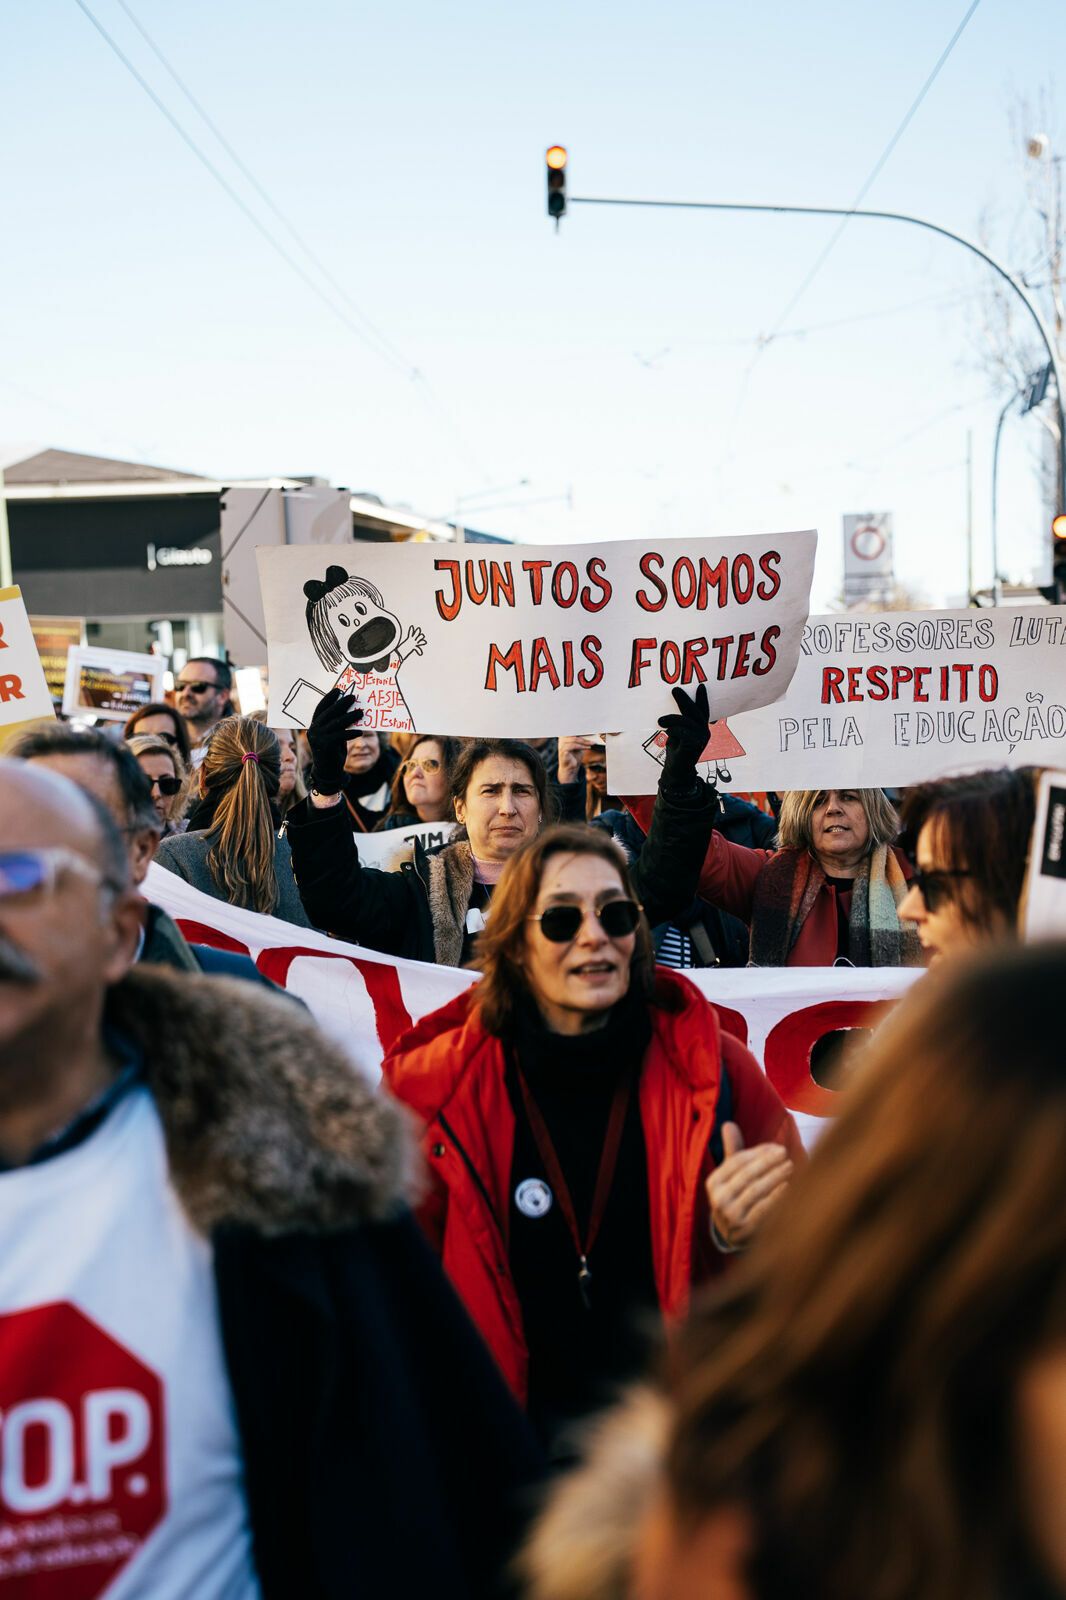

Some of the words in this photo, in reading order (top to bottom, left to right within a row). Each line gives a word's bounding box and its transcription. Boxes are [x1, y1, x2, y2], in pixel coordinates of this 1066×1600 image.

[434, 557, 612, 621] JUNTOS
[636, 550, 781, 612] SOMOS
[484, 635, 604, 693] MAIS
[628, 625, 781, 688] FORTES
[800, 619, 995, 655] ROFESSORES
[1009, 616, 1066, 648] LUT
[821, 664, 999, 704] RESPEITO
[779, 716, 864, 752] PELA
[894, 692, 1066, 755] EDUCAÇÃO
[0, 1387, 152, 1514] O.P.
